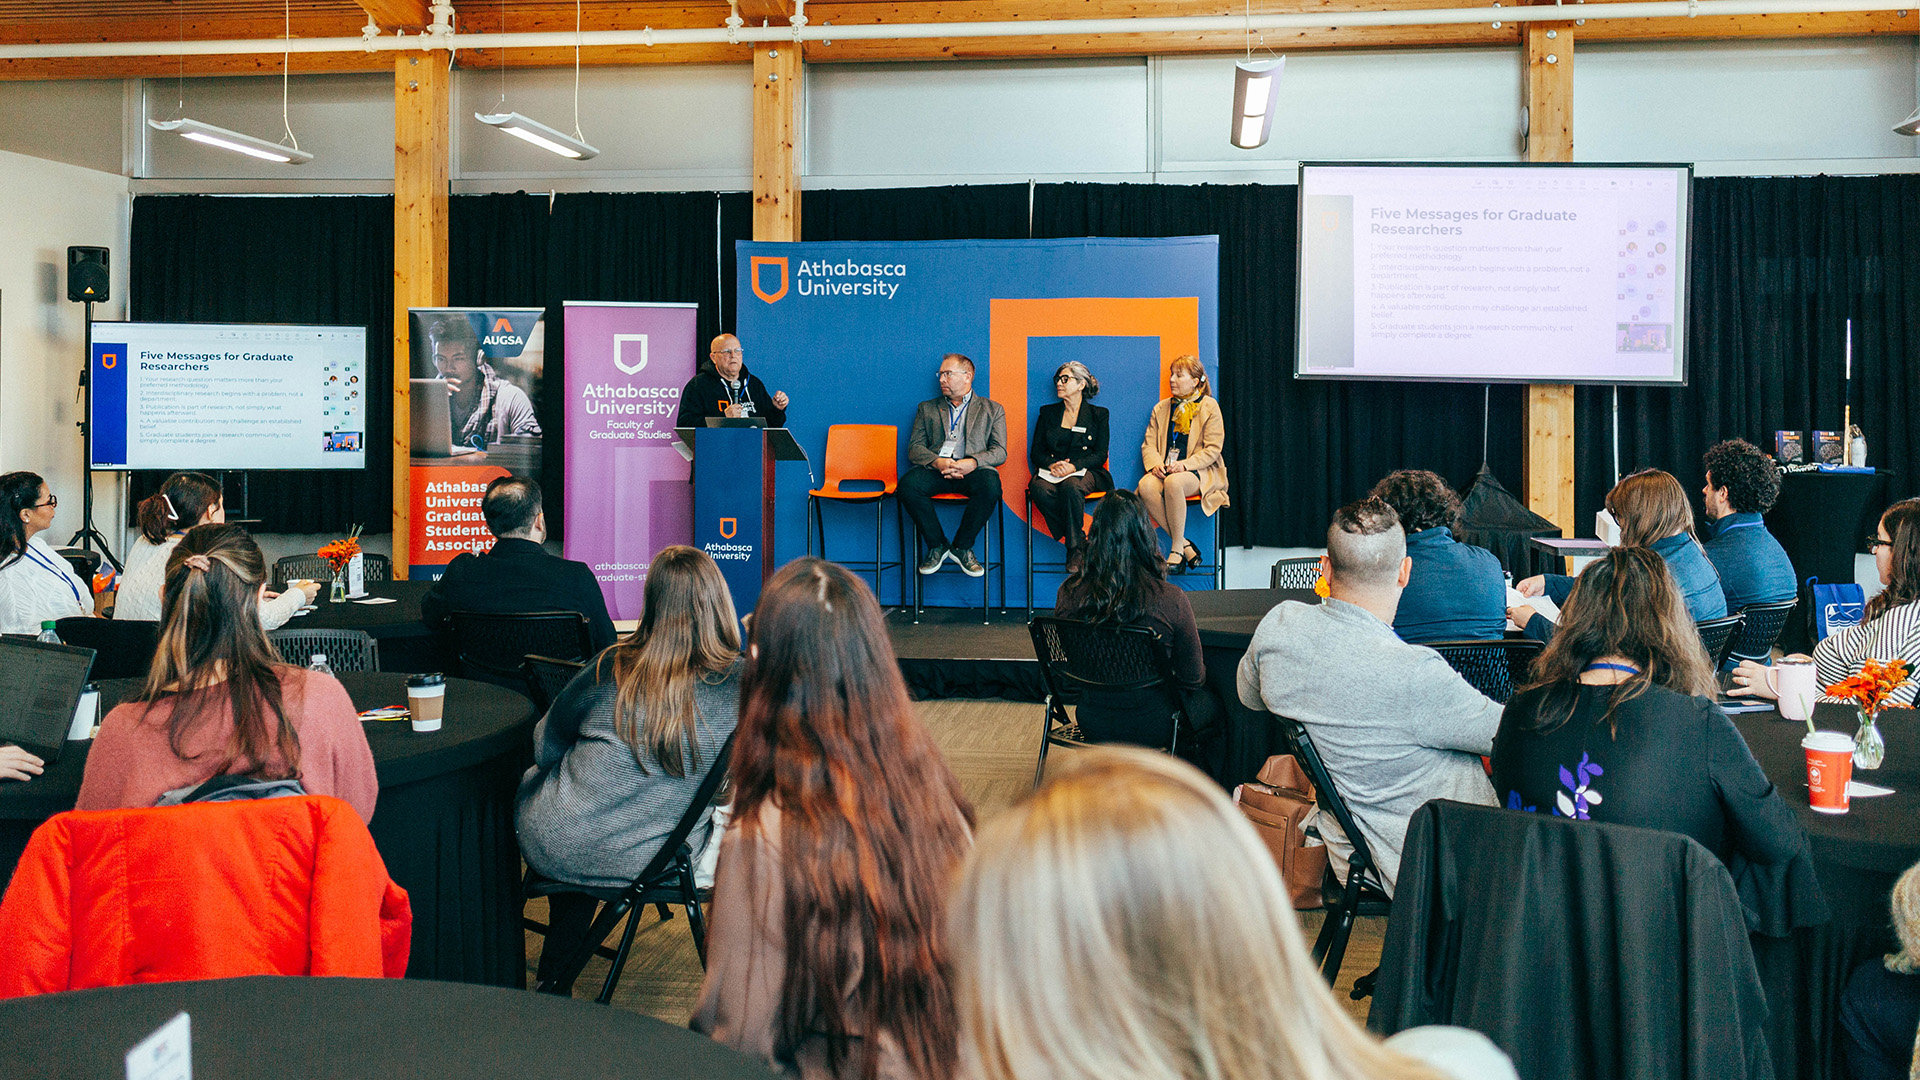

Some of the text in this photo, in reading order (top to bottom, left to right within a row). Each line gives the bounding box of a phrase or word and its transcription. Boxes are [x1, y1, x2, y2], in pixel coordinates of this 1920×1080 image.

[1371, 207, 1577, 223] Five Messages for Graduate
[1371, 223, 1462, 235] Researchers
[1432, 245, 1467, 253] question
[1524, 245, 1543, 253] than
[1371, 252, 1407, 260] preferred
[797, 259, 906, 276] Athabasca
[1379, 264, 1442, 273] Interdisciplinary
[1443, 264, 1477, 272] research
[1479, 265, 1505, 273] begins
[797, 279, 899, 300] University
[1379, 283, 1423, 291] Publication
[1513, 285, 1539, 294] simply
[1371, 292, 1405, 300] happens
[1387, 303, 1420, 311] valuable
[1491, 304, 1529, 313] challenge
[1543, 304, 1588, 312] established
[1452, 324, 1467, 332] join
[483, 336, 523, 345] AUGSA
[1371, 331, 1397, 339] simply
[1398, 332, 1436, 340] complete
[140, 351, 294, 362] Five Messages for Graduate
[140, 362, 209, 371] Researchers
[582, 383, 679, 398] Athabasca
[585, 400, 676, 418] University
[607, 420, 654, 430] Faculty of
[589, 430, 672, 439] Graduate Studies
[425, 481, 488, 493] Athabas
[425, 495, 483, 508] Univers
[425, 510, 487, 522] Graduat
[425, 538, 497, 551] Associati
[705, 543, 752, 551] Athabasca
[595, 562, 650, 570] athabascau
